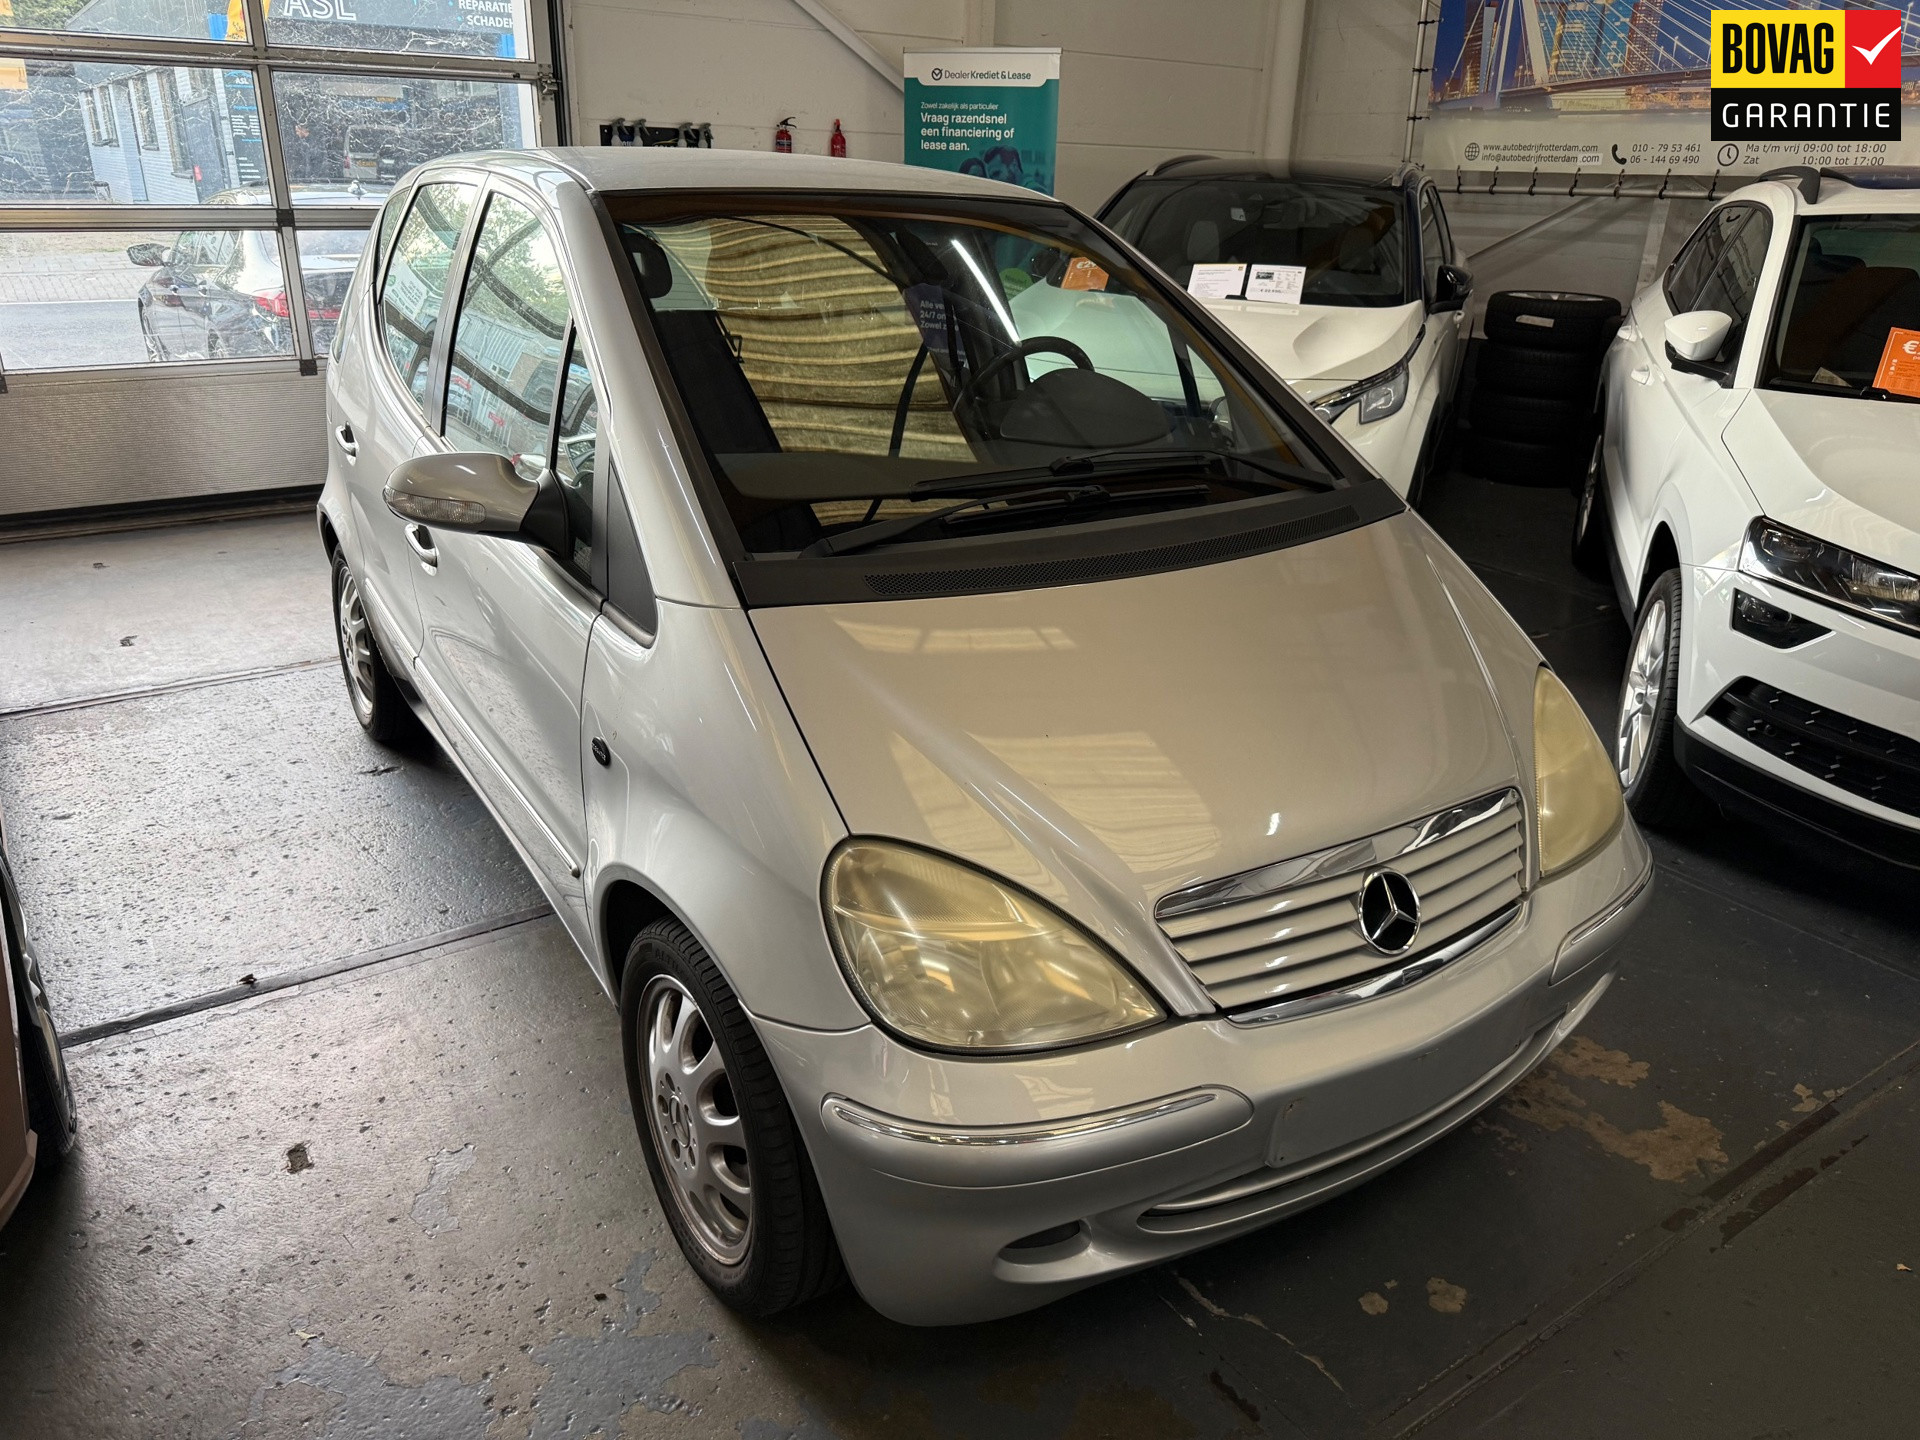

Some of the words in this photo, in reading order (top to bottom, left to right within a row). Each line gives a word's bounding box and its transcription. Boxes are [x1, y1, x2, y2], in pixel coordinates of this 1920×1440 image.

[1000, 71, 1007, 80] &
[1007, 71, 1032, 80] Lease
[920, 101, 938, 110] Zowel
[938, 102, 959, 111] zakelijk
[960, 102, 969, 110] als
[969, 103, 999, 111] particulier
[920, 112, 949, 126] Vraag
[951, 113, 1007, 125] razendsnel
[920, 127, 940, 137] een
[941, 126, 1002, 141] financiering
[1003, 128, 1015, 139] of
[920, 139, 947, 150] lease
[948, 141, 970, 151] aan.
[1482, 143, 1599, 153] www.autobedrijfrotterdam.com
[1632, 143, 1649, 153] 010
[1658, 143, 1669, 153] 79
[1670, 143, 1683, 153] 53
[1684, 143, 1701, 153] 461
[1745, 143, 1760, 153] Ma
[1762, 143, 1780, 154] t/m
[1783, 143, 1800, 155] vrij
[1802, 143, 1833, 153] 09:00
[1836, 143, 1851, 153] tot
[1854, 143, 1887, 154] 18:00
[1629, 155, 1641, 164] 06
[1650, 155, 1667, 164] 144
[1668, 155, 1681, 165] 69
[1682, 155, 1700, 165] 490
[1743, 155, 1760, 165] Zat
[1801, 156, 1832, 166] 10:00
[1834, 157, 1849, 166] tot
[1852, 156, 1885, 167] 17:00
[920, 300, 934, 309] Alle
[920, 310, 936, 319] 24/7
[920, 320, 942, 330] Zowel
